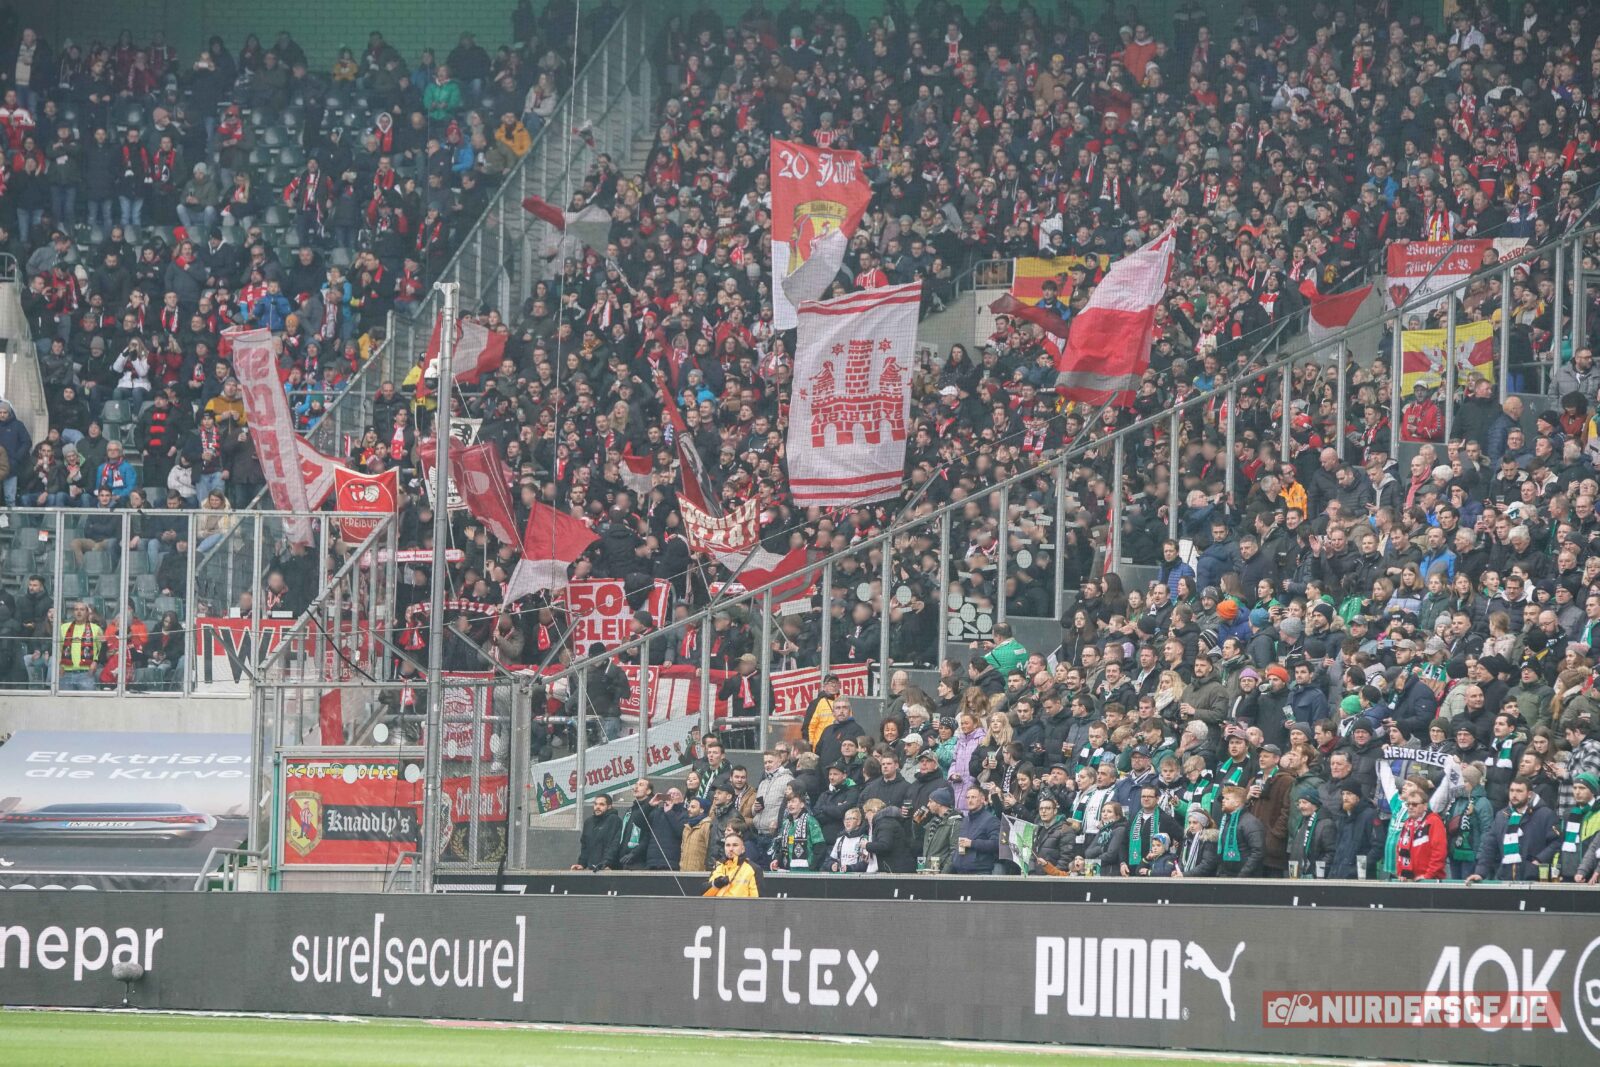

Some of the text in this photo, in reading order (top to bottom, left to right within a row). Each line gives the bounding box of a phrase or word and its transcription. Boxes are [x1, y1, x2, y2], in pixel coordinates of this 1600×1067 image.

[779, 150, 809, 180] 20
[344, 516, 381, 529] FREIBUR
[774, 678, 865, 713] SYNSIA
[25, 752, 272, 764] Elektrisier
[646, 744, 672, 768] ike
[25, 767, 250, 779] die Kurve.
[327, 809, 411, 838] Knaddly's
[1035, 936, 1181, 1020] PUMA
